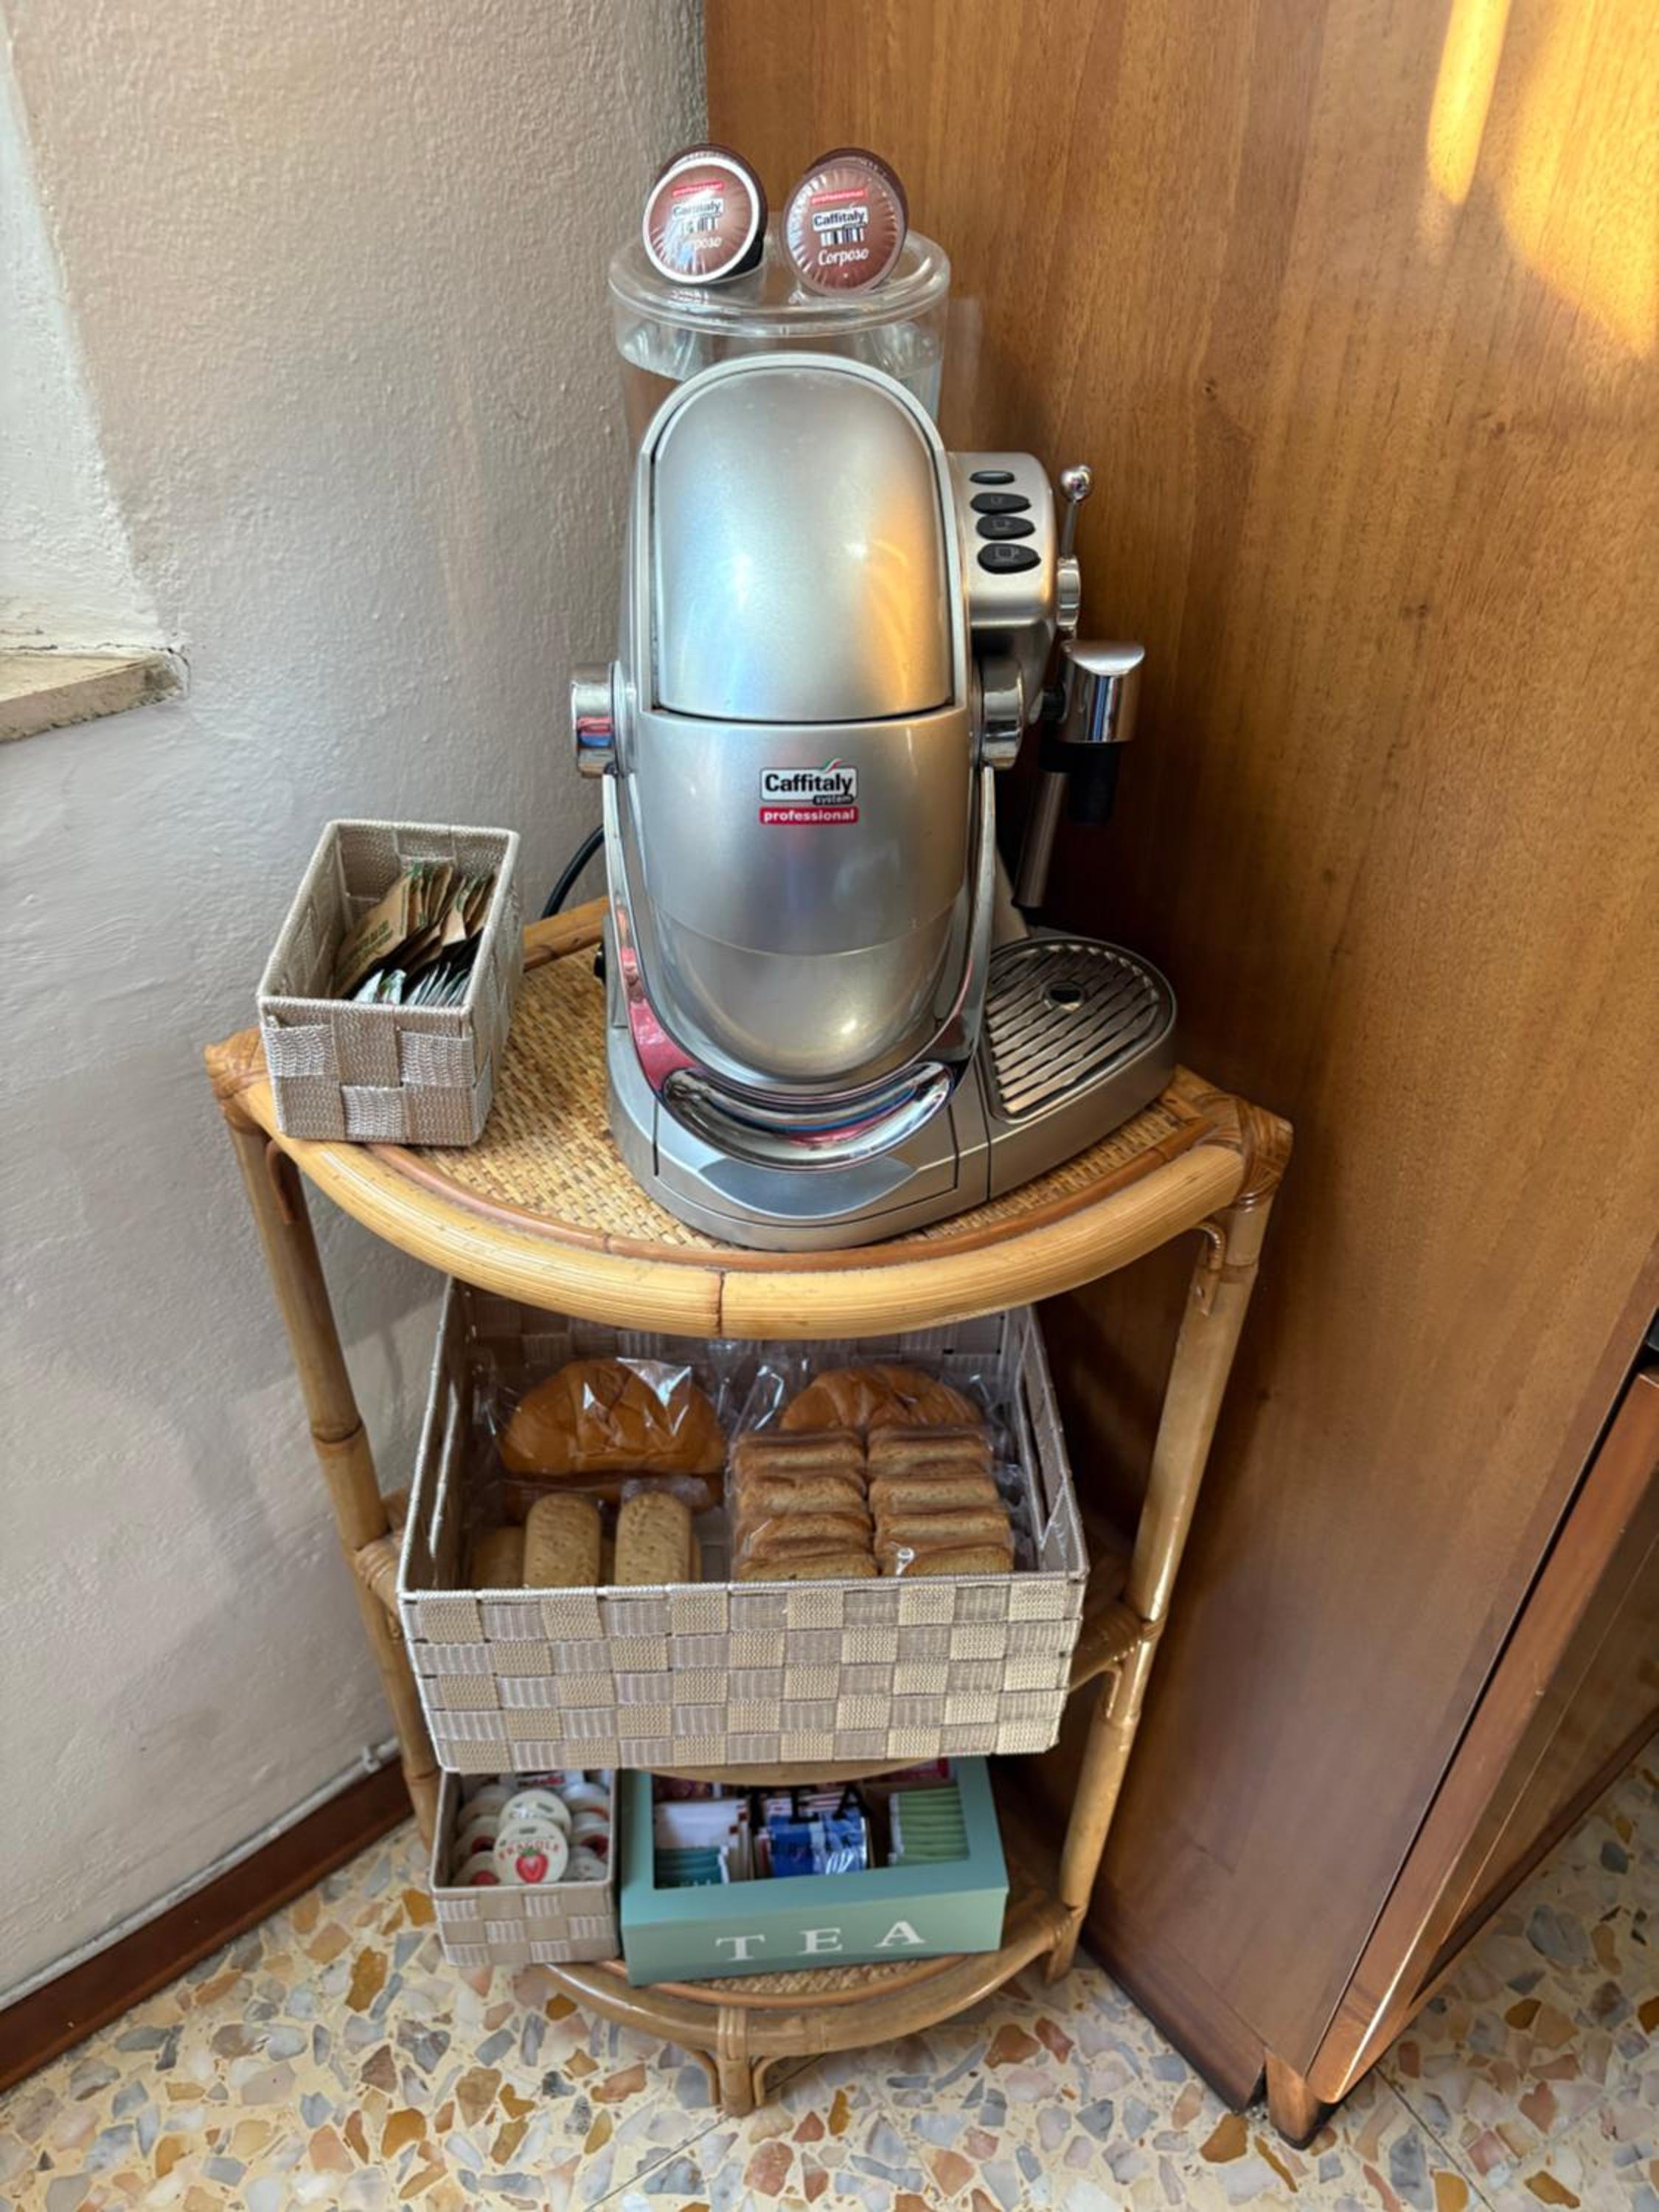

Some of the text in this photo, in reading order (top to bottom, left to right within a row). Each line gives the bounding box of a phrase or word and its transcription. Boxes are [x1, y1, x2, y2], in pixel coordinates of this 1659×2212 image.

[813, 209, 866, 227] Caffitaly
[818, 248, 870, 268] Corposo
[765, 773, 853, 796] Caffitaly
[763, 809, 855, 823] professional
[715, 1919, 927, 1963] TEA
